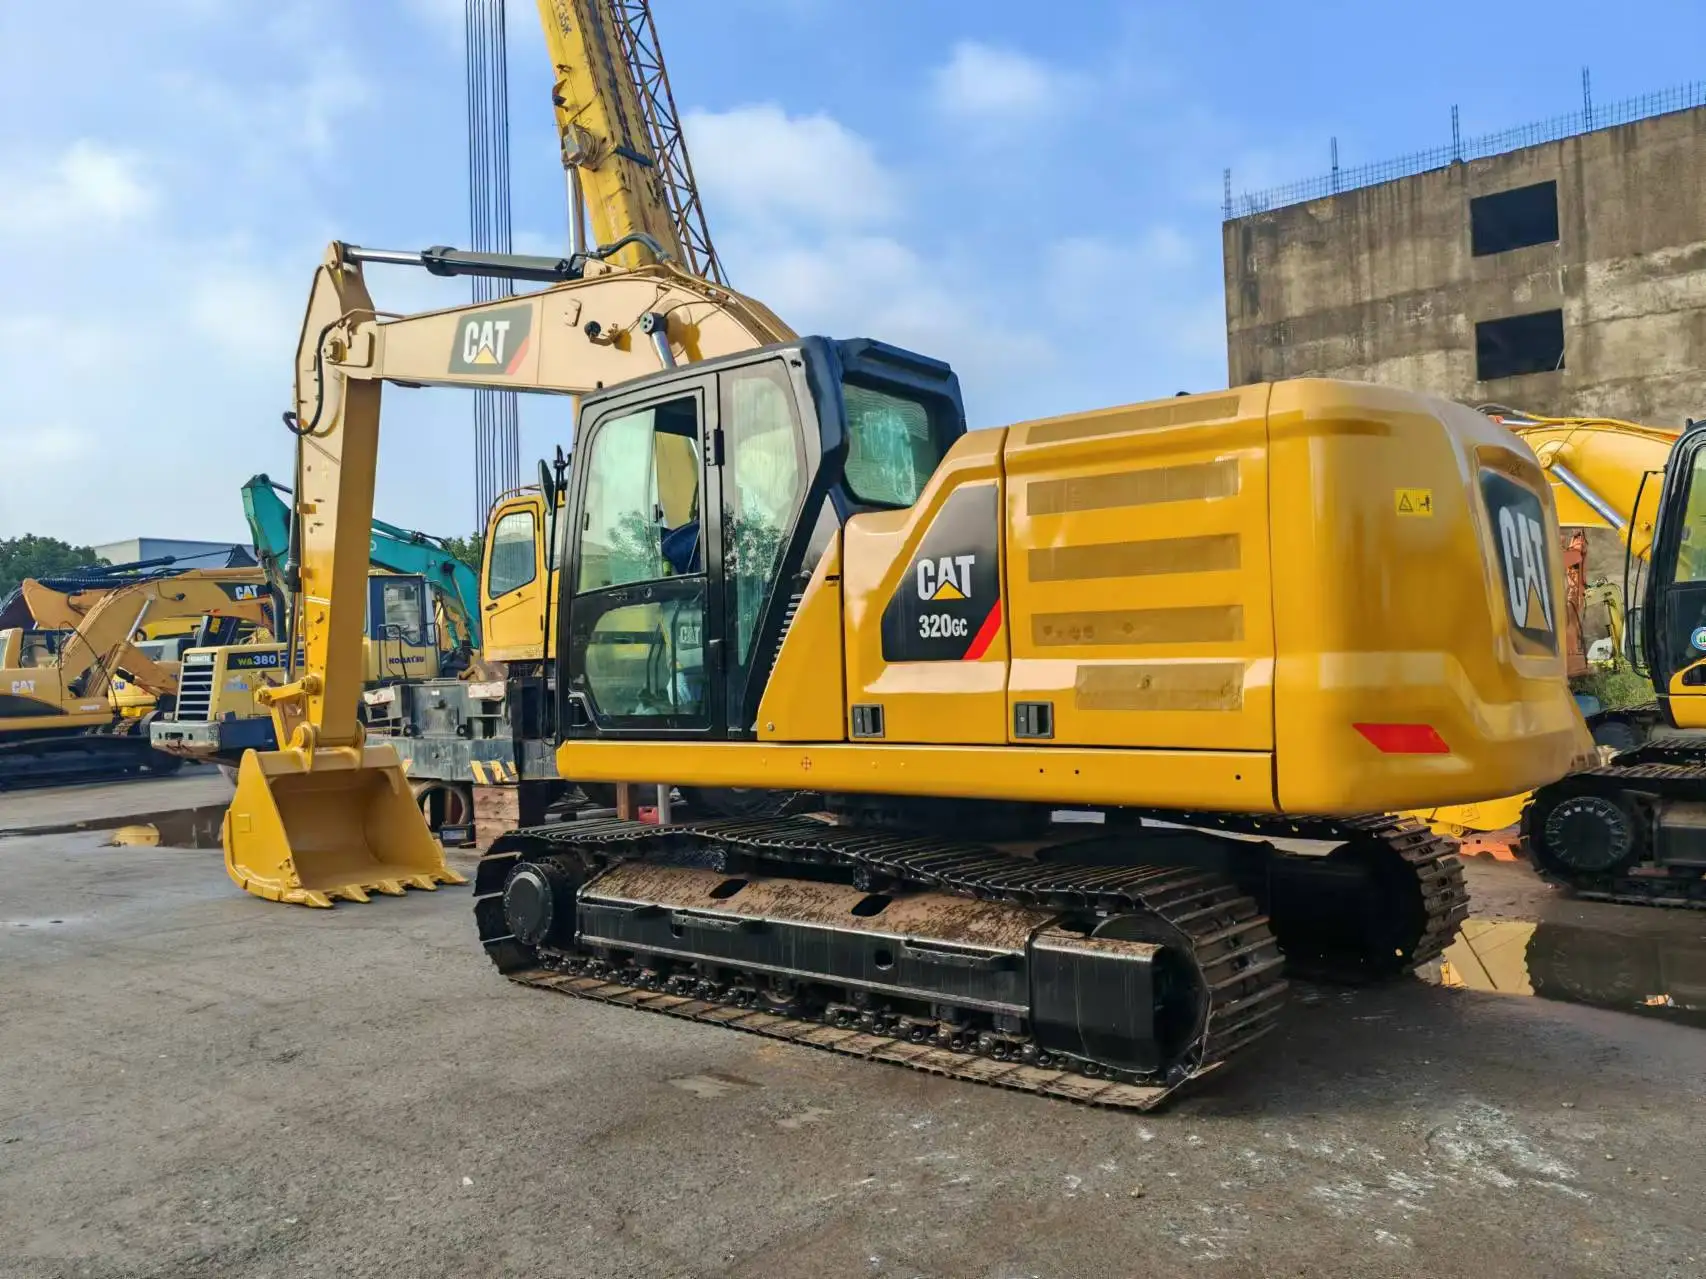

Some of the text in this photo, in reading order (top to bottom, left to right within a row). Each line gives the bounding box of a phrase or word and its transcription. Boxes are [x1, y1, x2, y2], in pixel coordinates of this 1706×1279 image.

[463, 320, 510, 364] CAT
[917, 554, 975, 601] CAT
[1498, 506, 1553, 632] CAT
[235, 585, 258, 600] CAT
[680, 626, 701, 645] CAT
[11, 680, 35, 695] CAT
